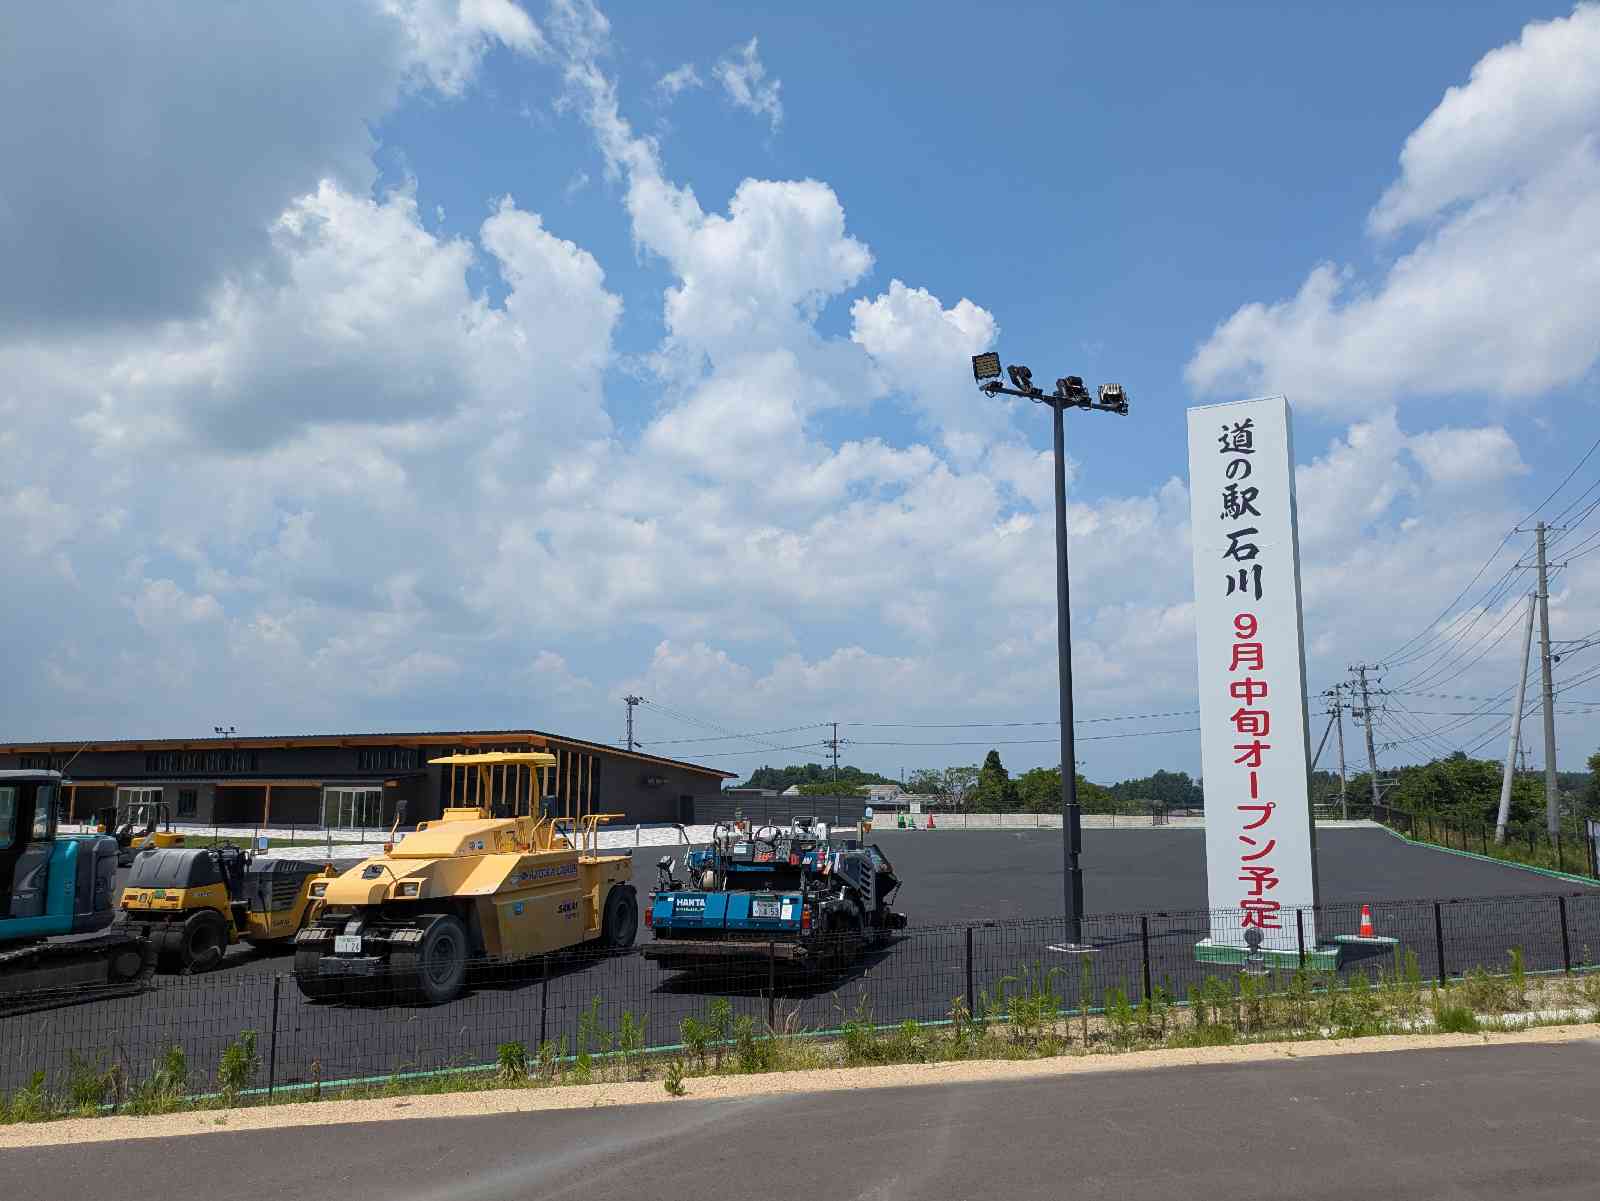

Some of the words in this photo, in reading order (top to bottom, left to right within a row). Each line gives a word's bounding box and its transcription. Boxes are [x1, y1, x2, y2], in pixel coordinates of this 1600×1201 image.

[1217, 417, 1263, 601] 道の駅石川
[1229, 612, 1282, 929] 9月中旬オープン予定
[676, 898, 706, 907] HANTA
